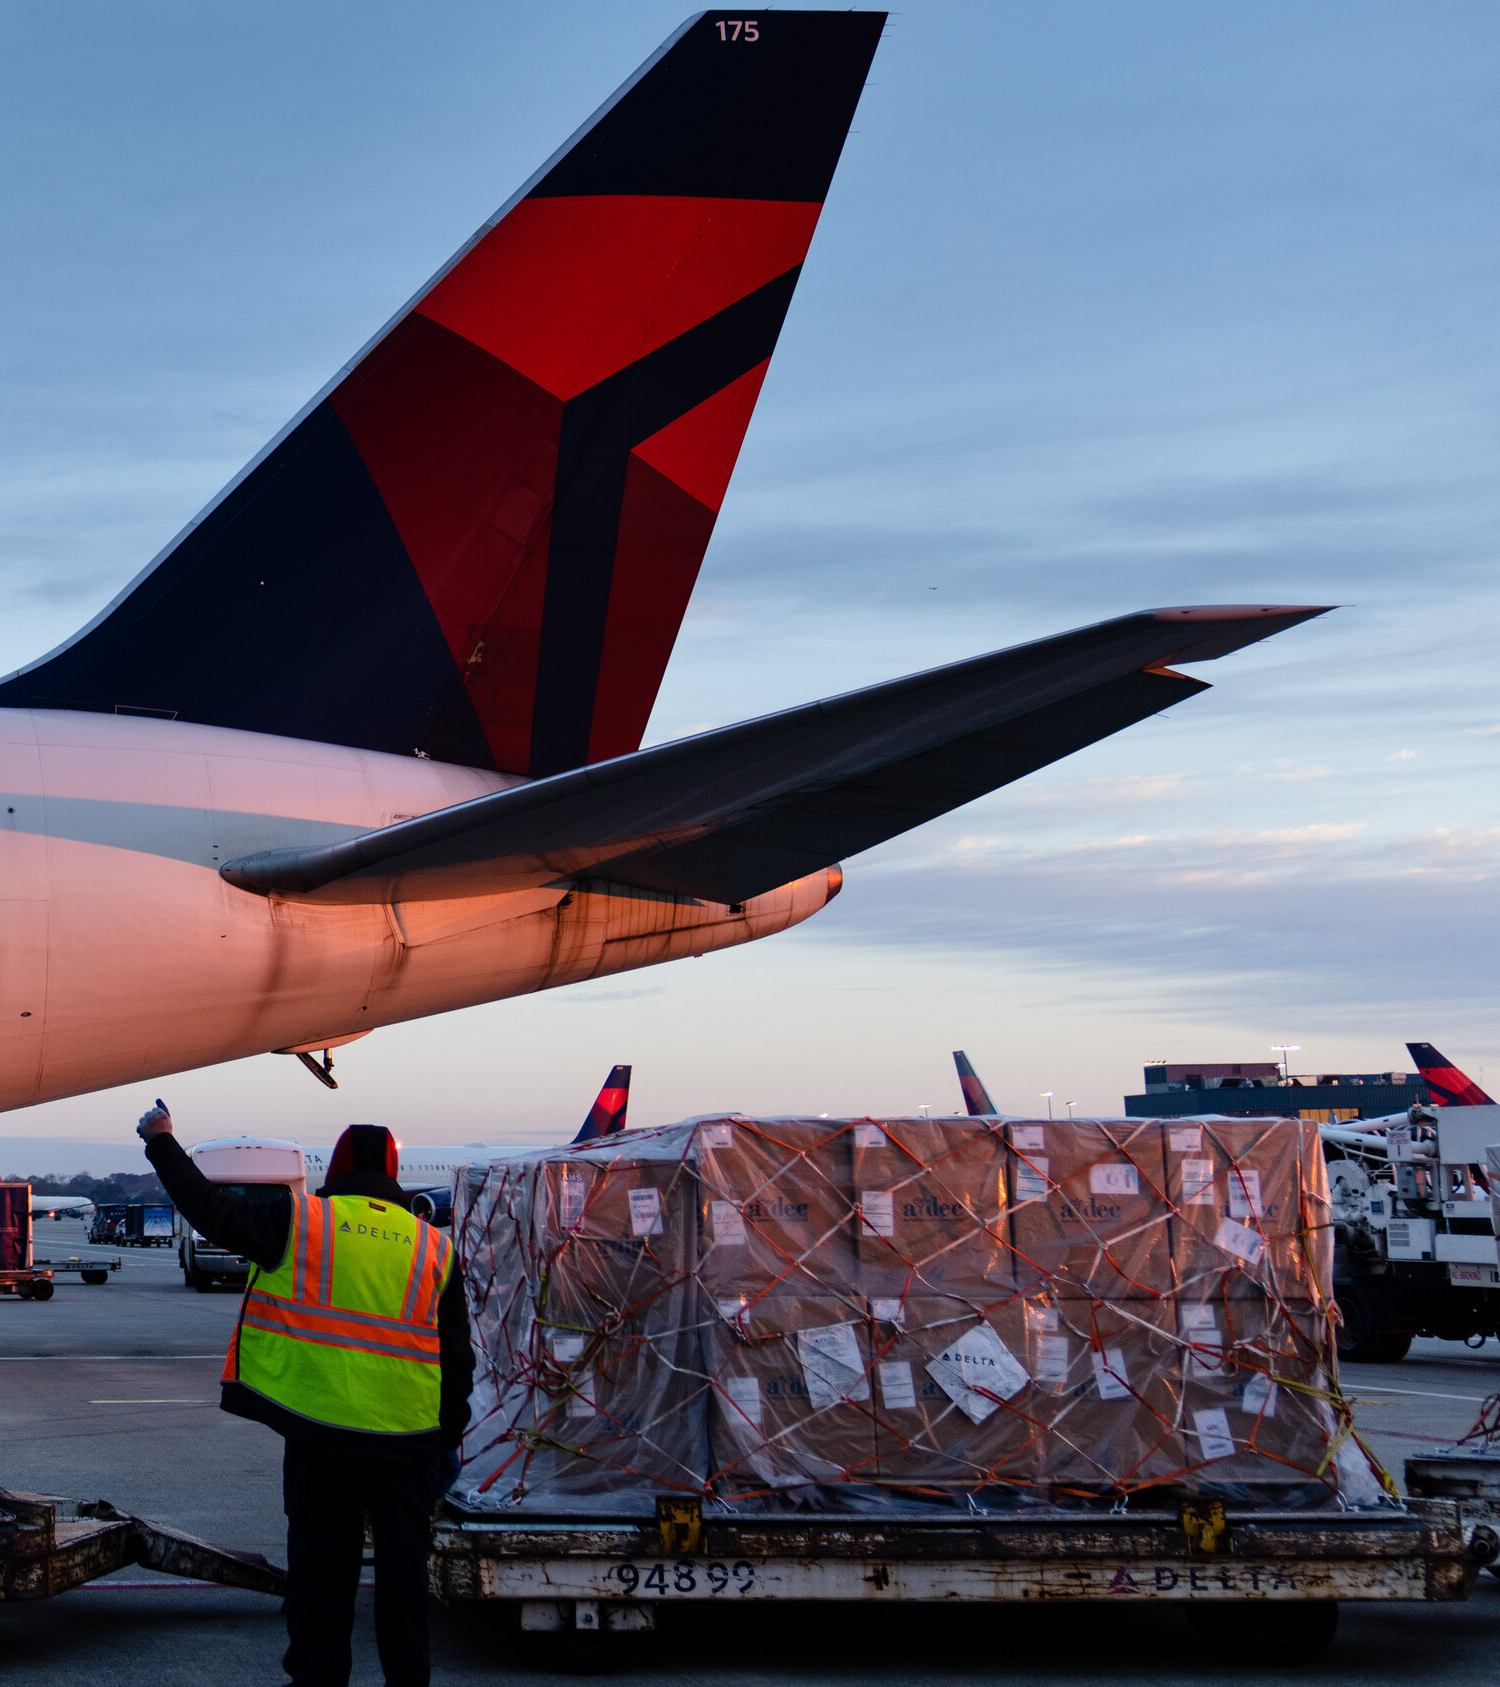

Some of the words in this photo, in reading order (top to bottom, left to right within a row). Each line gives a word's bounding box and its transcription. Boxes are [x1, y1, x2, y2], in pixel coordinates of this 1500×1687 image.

[715, 20, 760, 42] 175
[357, 1223, 412, 1246] DELTA
[955, 1353, 995, 1367] DELTA
[616, 1562, 757, 1595] 94899
[1154, 1565, 1299, 1592] DELTA
